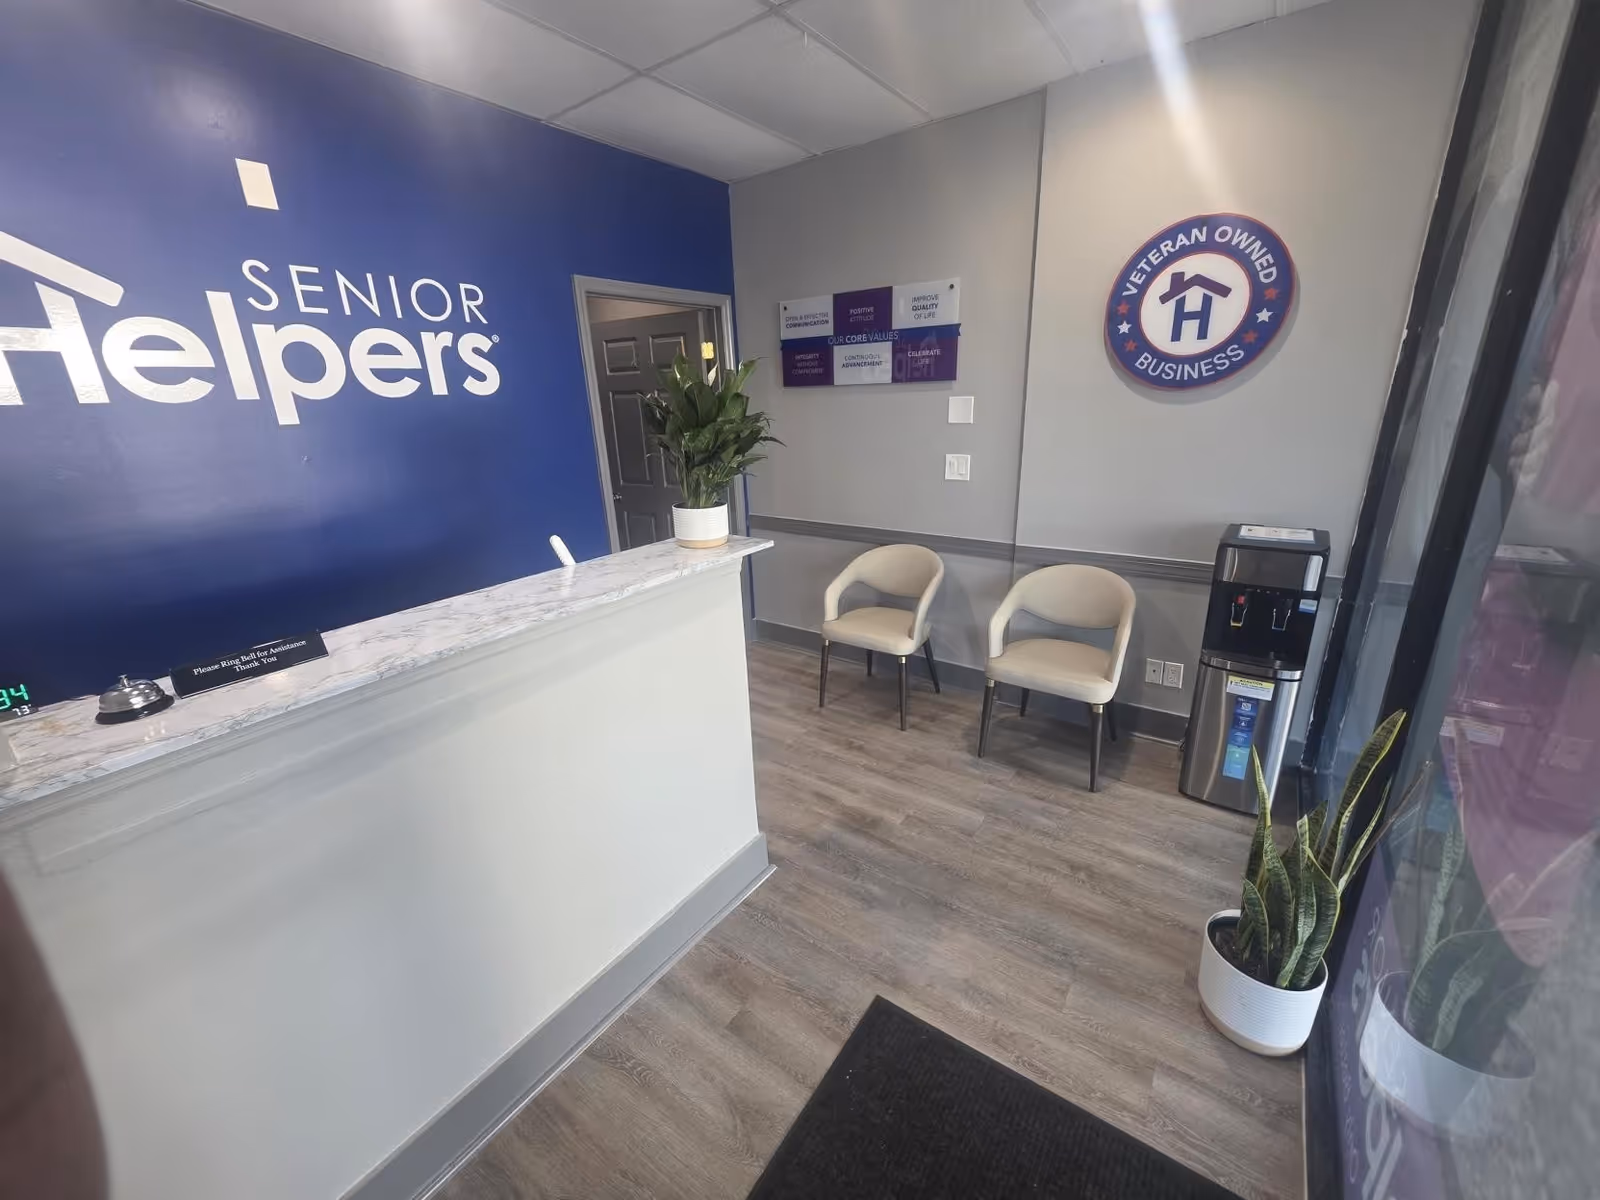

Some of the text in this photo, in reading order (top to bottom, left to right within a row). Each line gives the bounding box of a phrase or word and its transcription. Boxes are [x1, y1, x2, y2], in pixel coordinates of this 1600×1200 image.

[1122, 225, 1277, 297] VETERAN OWNED
[241, 259, 488, 323] SENIOR
[849, 307, 874, 315] POSITIVE
[911, 302, 939, 312] QUALITY
[785, 319, 829, 329] COMMUNICATION
[827, 331, 899, 345] OUR CORE VALUES
[0, 282, 500, 425] Helpers
[908, 349, 941, 357] CELEBRATE
[842, 360, 883, 369] ADVANCEMENT
[1135, 344, 1245, 380] BUSINESS
[193, 640, 307, 676] Please Ring Bell for Assistance
[234, 656, 278, 672] Thank You
